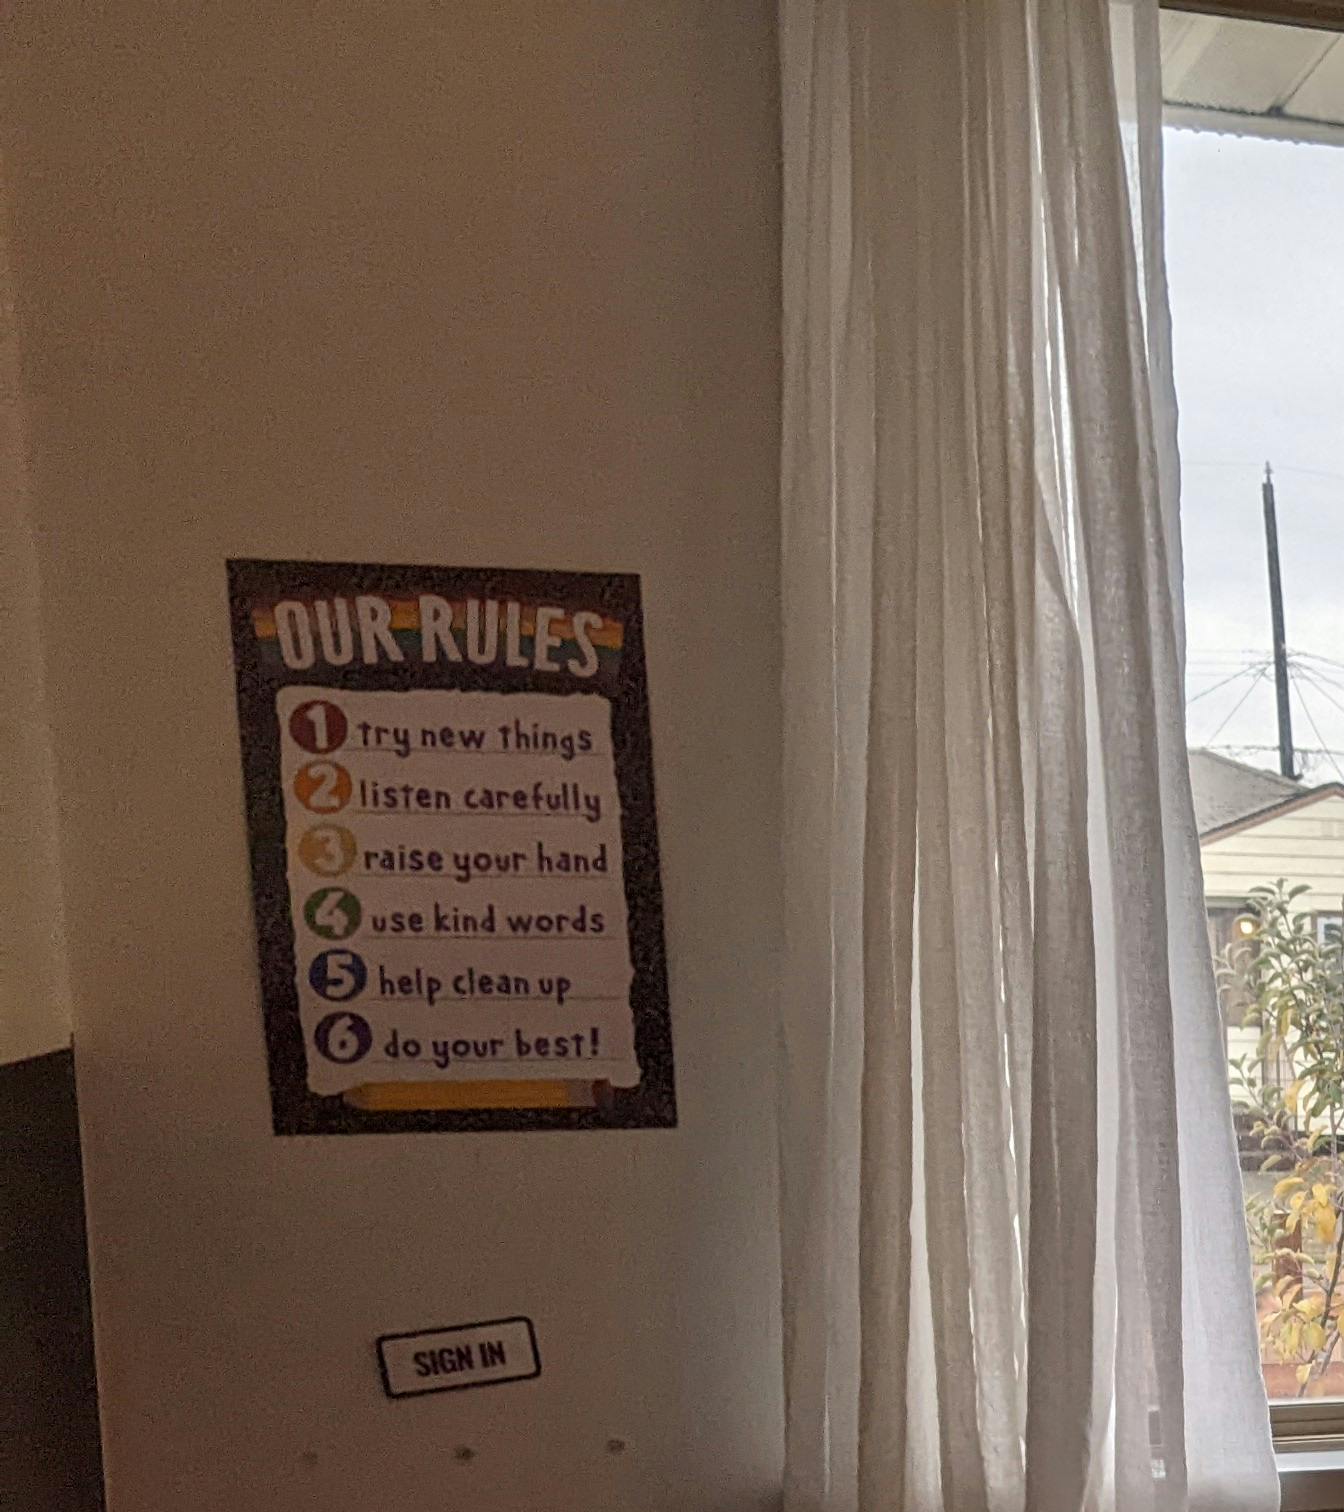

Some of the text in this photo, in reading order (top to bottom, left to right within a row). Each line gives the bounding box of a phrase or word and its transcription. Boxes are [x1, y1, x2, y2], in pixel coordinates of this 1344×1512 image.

[275, 596, 603, 677] OUR RULES
[306, 703, 593, 760] 1 try new things
[306, 764, 602, 823] 2 listen carefully
[316, 826, 607, 883] 3 raise your hand
[316, 890, 605, 937] 4 use kind words
[324, 952, 572, 1005] 5 help clean up
[328, 1015, 601, 1068] 6 do your best!
[413, 1340, 507, 1377] SIGN IN
